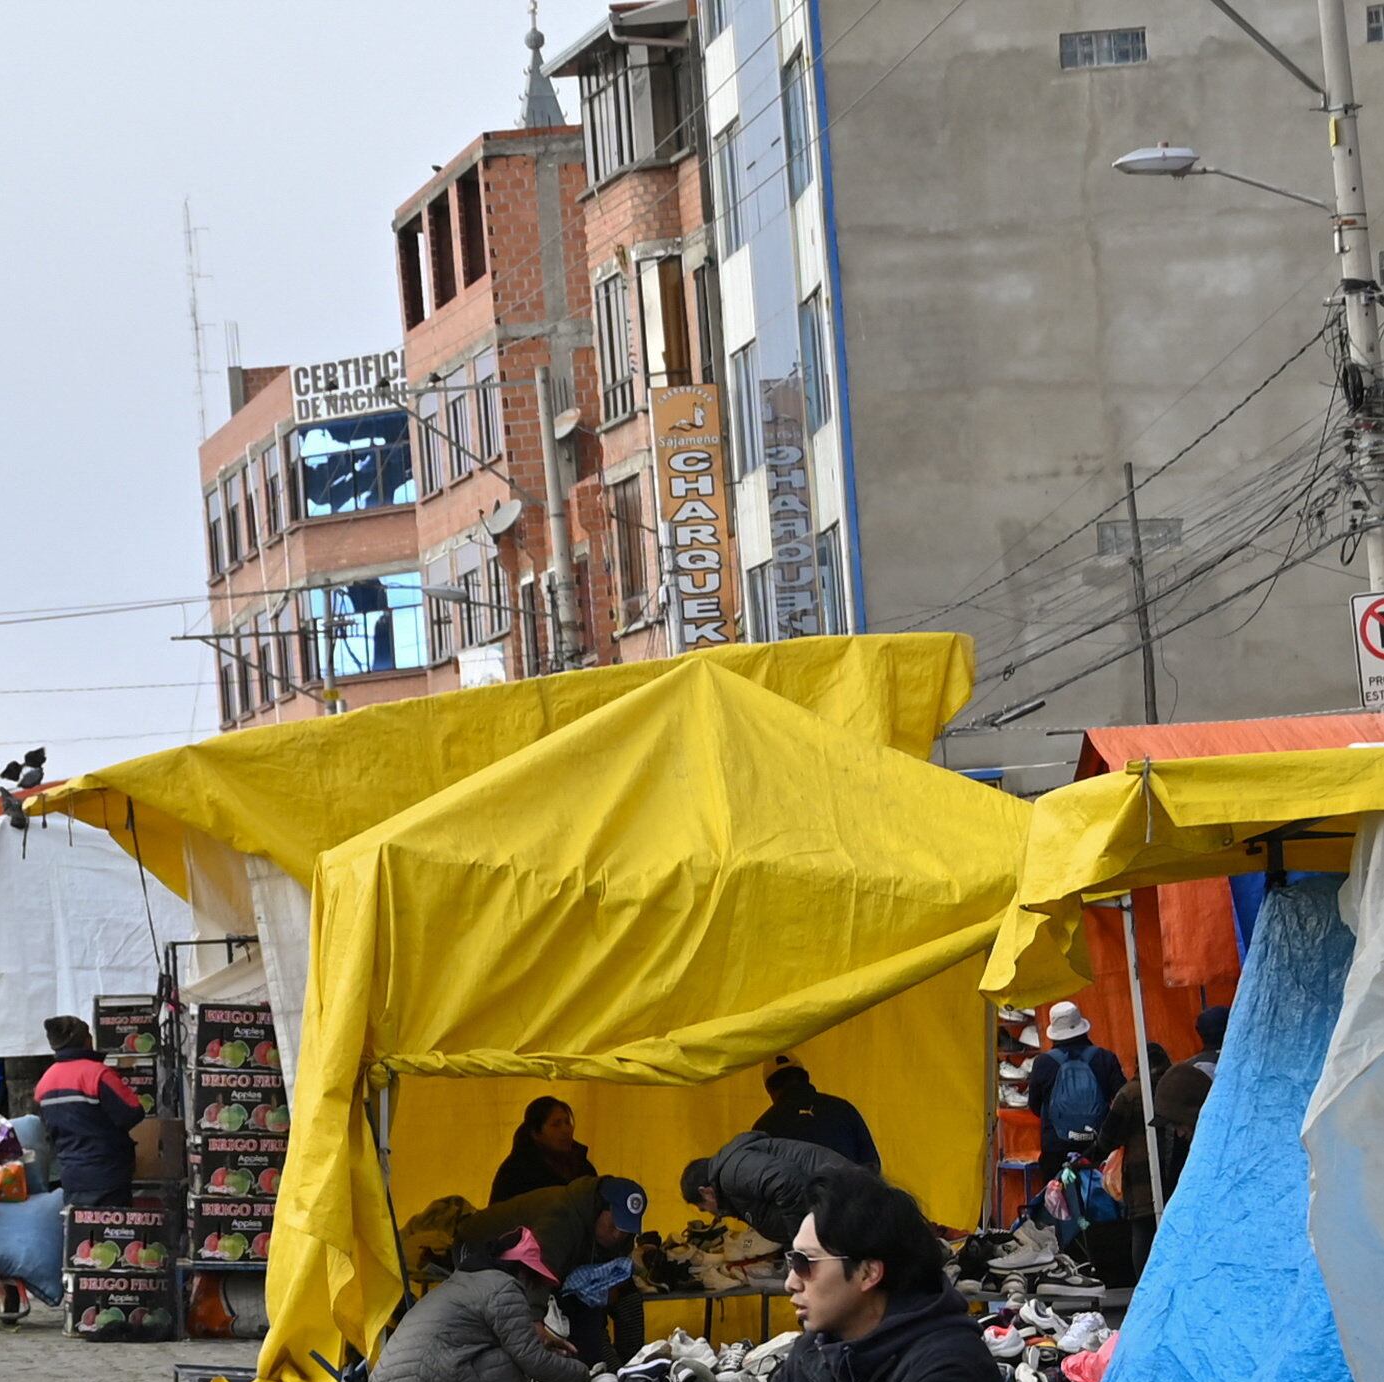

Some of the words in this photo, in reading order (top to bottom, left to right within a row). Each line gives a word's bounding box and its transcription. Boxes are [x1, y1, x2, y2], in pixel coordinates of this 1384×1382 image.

[296, 396, 321, 421] DE
[667, 448, 730, 650] CHARQUEK
[1368, 675, 1384, 687] PR
[100, 1016, 128, 1025] BRIGO
[205, 1009, 254, 1024] BRIGO
[234, 1026, 265, 1036] Apples
[201, 1074, 250, 1087] BRIGO
[231, 1090, 262, 1099] Apples
[208, 1138, 258, 1152] BRIGO
[238, 1154, 269, 1163] Apples
[202, 1203, 251, 1217] BRIGO
[74, 1210, 124, 1225] BRIGO
[126, 1212, 165, 1226] FRUT
[231, 1220, 263, 1229] Apples
[104, 1227, 135, 1236] Apples
[79, 1277, 128, 1291] BRIGO
[130, 1278, 169, 1291] FRUT
[109, 1294, 140, 1303] Apples
